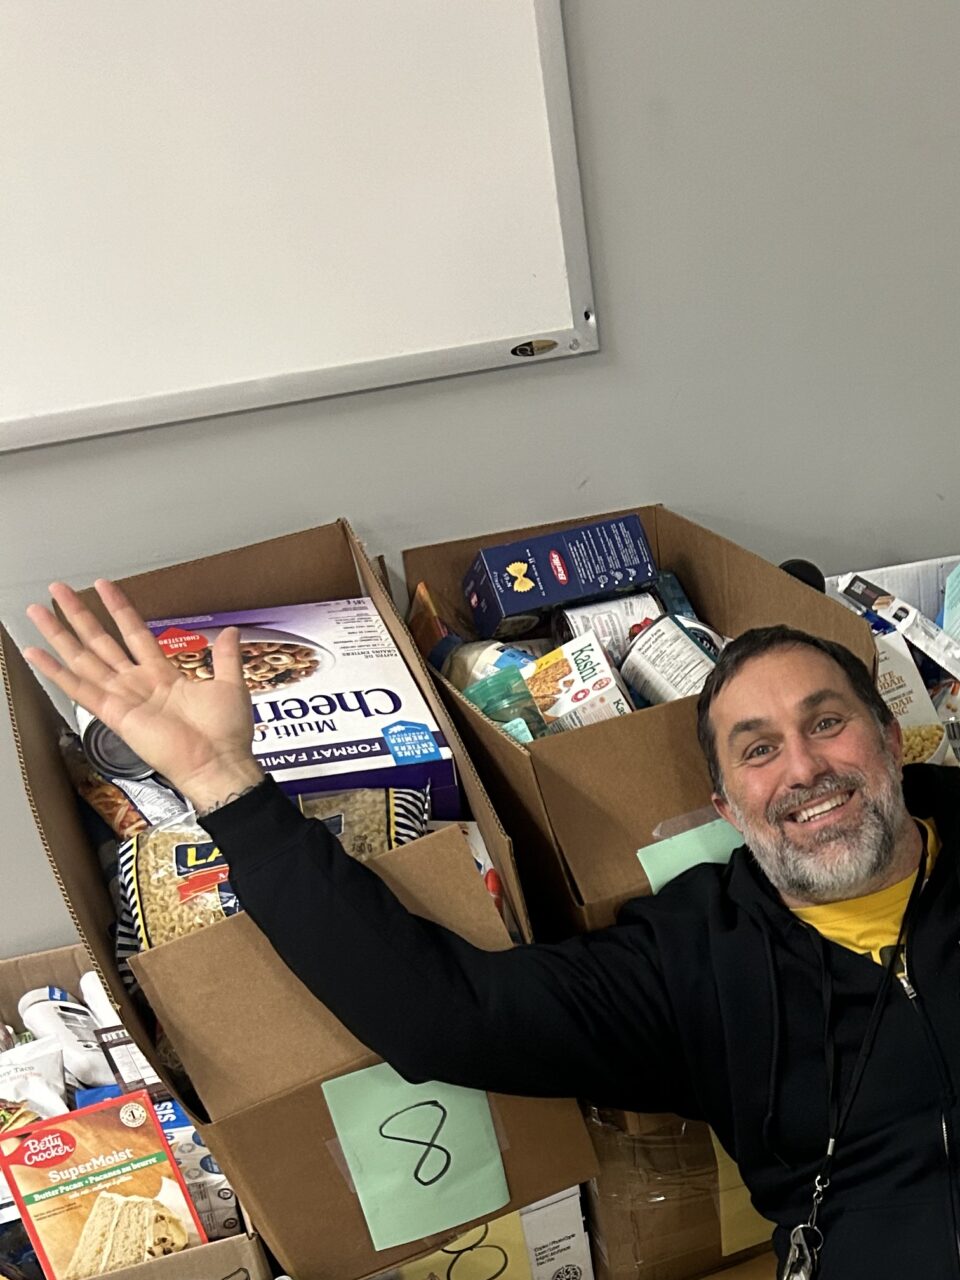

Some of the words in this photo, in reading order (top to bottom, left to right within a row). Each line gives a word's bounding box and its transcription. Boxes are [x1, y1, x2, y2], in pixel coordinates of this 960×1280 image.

[550, 552, 567, 583] Barilla
[169, 640, 188, 649] SANS
[571, 642, 597, 684] Kashi
[253, 688, 402, 725] Cheeri
[613, 699, 630, 714] Kas
[278, 719, 337, 740] Multi
[258, 753, 308, 768] FAMIL
[312, 743, 381, 761] FORMAT
[24, 1133, 62, 1153] Betty
[24, 1142, 75, 1165] Crocker
[379, 1100, 451, 1187] 8
[48, 1147, 134, 1183] SuperMoist
[33, 1186, 59, 1202] Butter
[59, 1180, 84, 1196] Pecan
[88, 1168, 122, 1185] Pacanes
[130, 1156, 157, 1172] beurre
